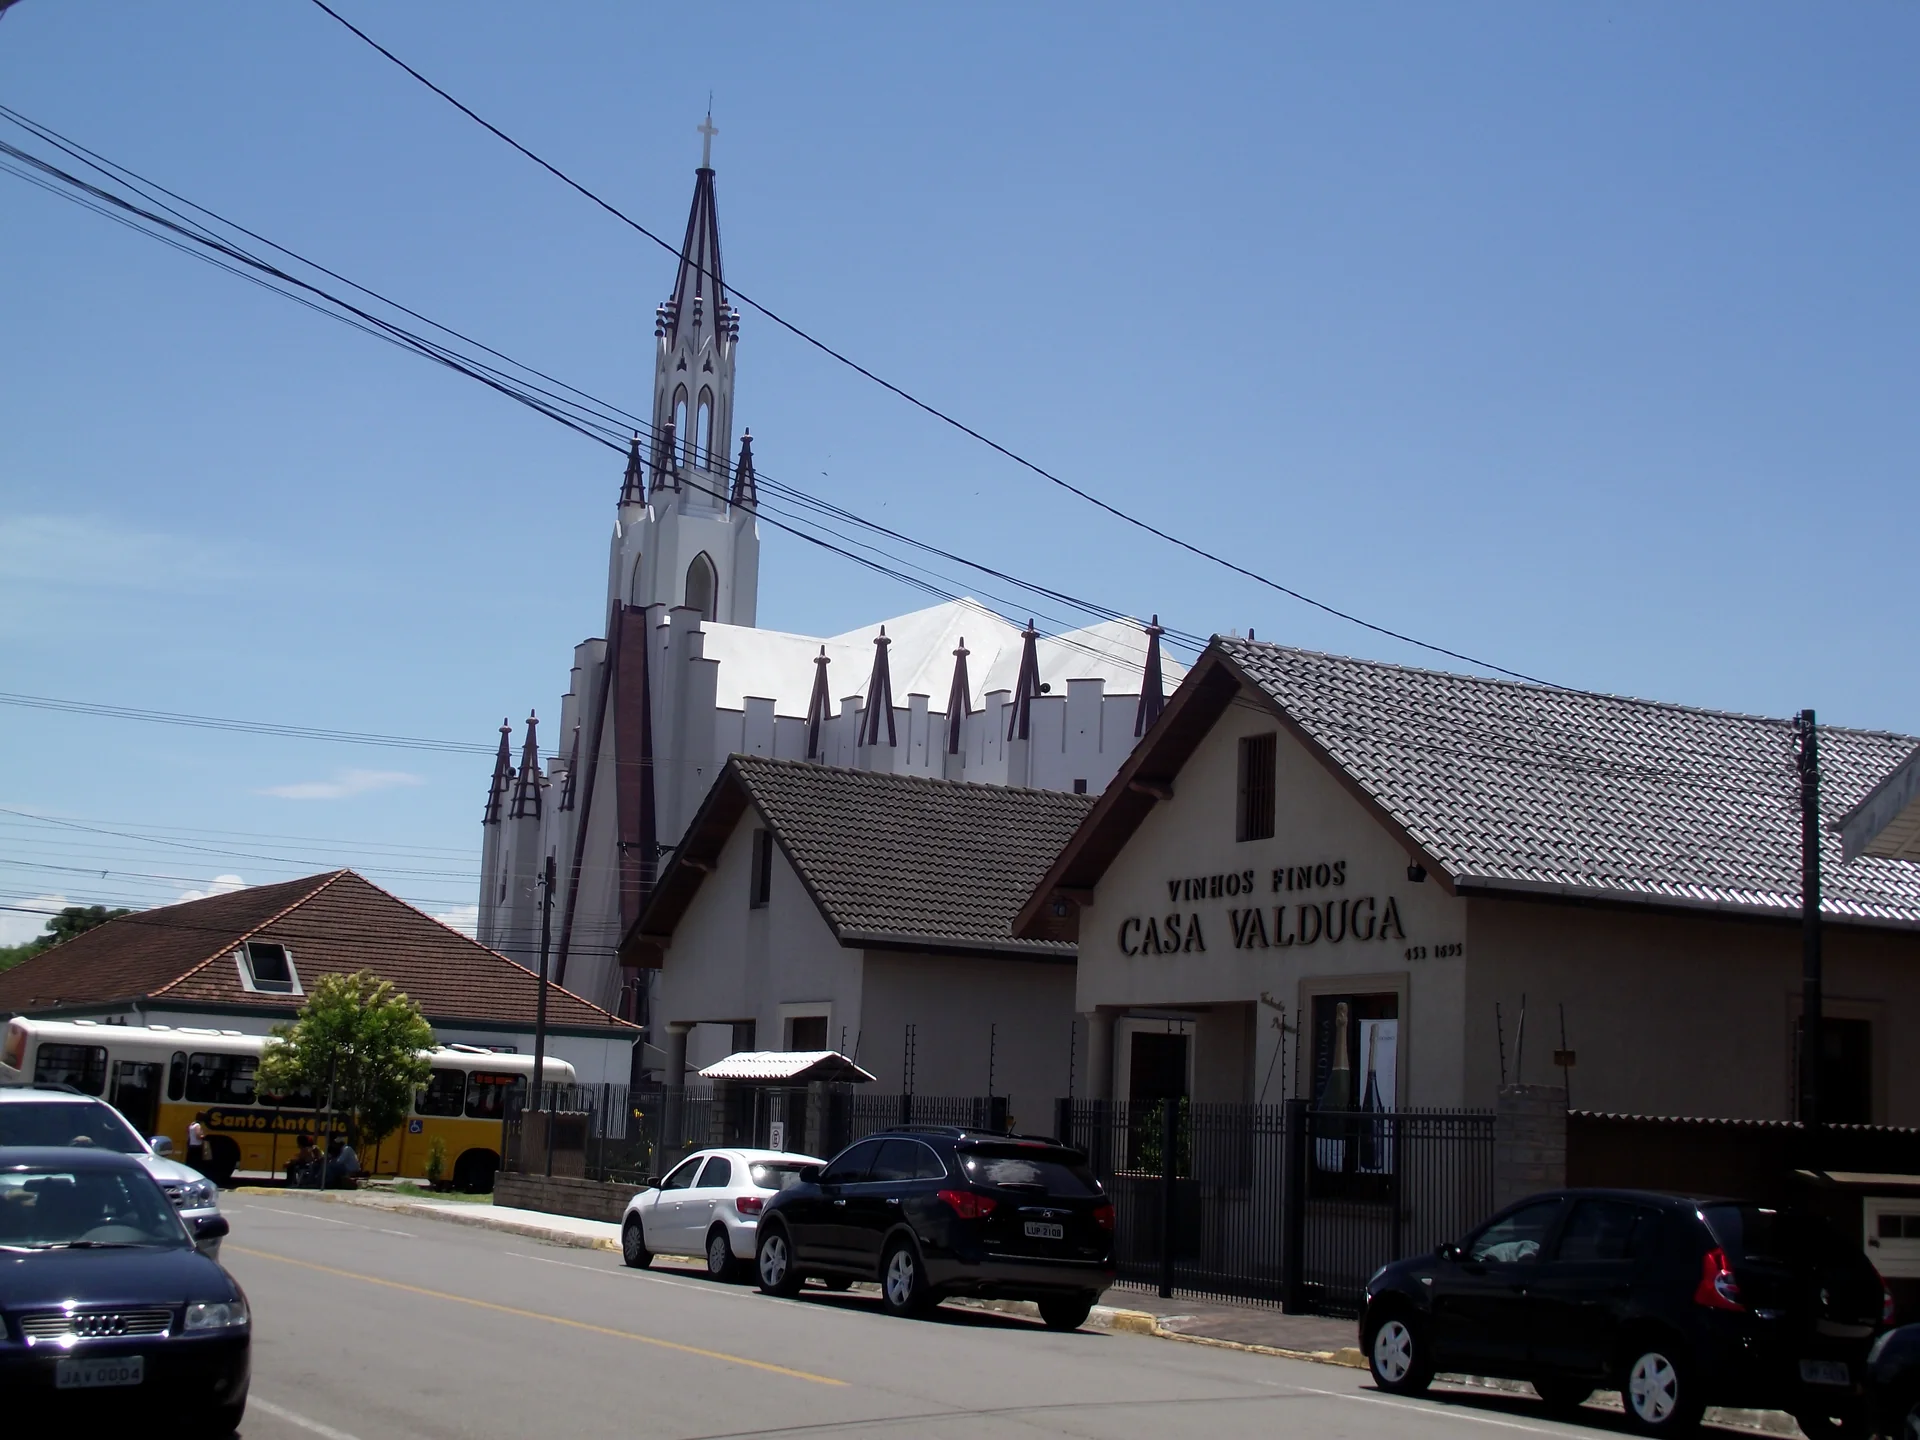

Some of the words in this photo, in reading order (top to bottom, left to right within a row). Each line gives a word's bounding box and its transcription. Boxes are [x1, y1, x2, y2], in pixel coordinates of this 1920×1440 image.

[1168, 870, 1254, 901] VINHOS
[1271, 860, 1346, 893] FINOS
[1118, 913, 1206, 957] CASA
[1227, 896, 1406, 949] VALDUGA
[211, 1112, 267, 1129] Santo
